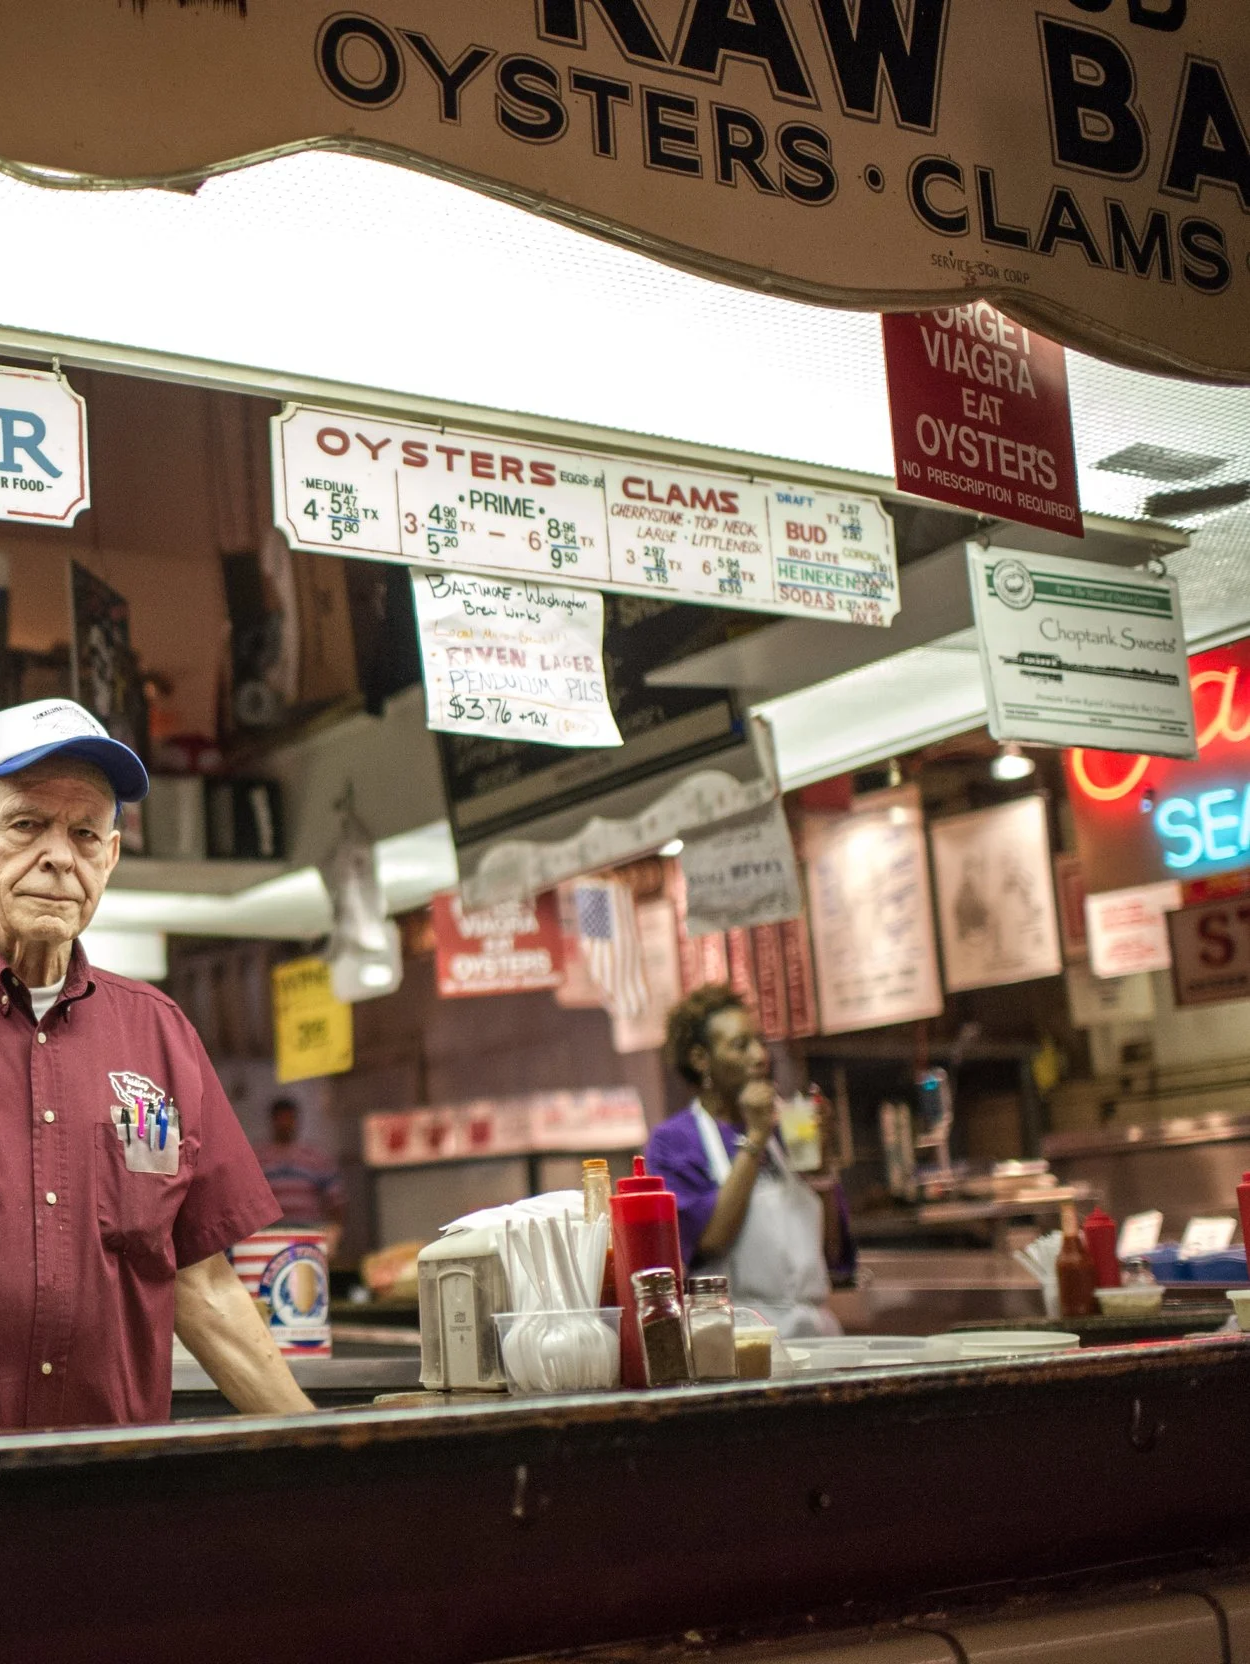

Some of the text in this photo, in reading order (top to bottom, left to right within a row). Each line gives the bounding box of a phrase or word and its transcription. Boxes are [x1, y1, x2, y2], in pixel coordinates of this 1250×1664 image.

[314, 10, 1233, 296] OYSTERS CLAMS
[976, 261, 1001, 281] SIGN
[1004, 268, 1030, 285] CORP
[915, 301, 1031, 355] ORGET
[921, 325, 1037, 399] VIAGRA
[962, 387, 1003, 426] EAT
[316, 427, 557, 487] OYSTERS
[916, 414, 1058, 491] OYSTERS
[622, 476, 739, 514] CLAMS
[776, 492, 814, 508] DRAFT
[902, 460, 1076, 522] NO PRESCRIPTION REQUIRED!
[362, 508, 379, 520] TX
[460, 520, 476, 533] TX
[611, 503, 758, 538] CHERRYSTONE TOP NECK
[580, 536, 595, 548] TX
[636, 526, 762, 553] LARGE LITTLENECK
[785, 521, 827, 545] BUD
[668, 560, 682, 571] TX
[788, 546, 839, 565] BUD LITE
[741, 571, 756, 583] TX
[777, 562, 857, 590] HEINEKEN
[463, 600, 540, 623] Brew Works
[524, 580, 587, 616] Washington
[779, 586, 835, 611] SODAS
[1039, 617, 1117, 652] Choptank
[445, 645, 596, 673] RAVEN LAGER
[449, 669, 603, 703] PENDULUM PILS
[448, 694, 512, 724] $3.76
